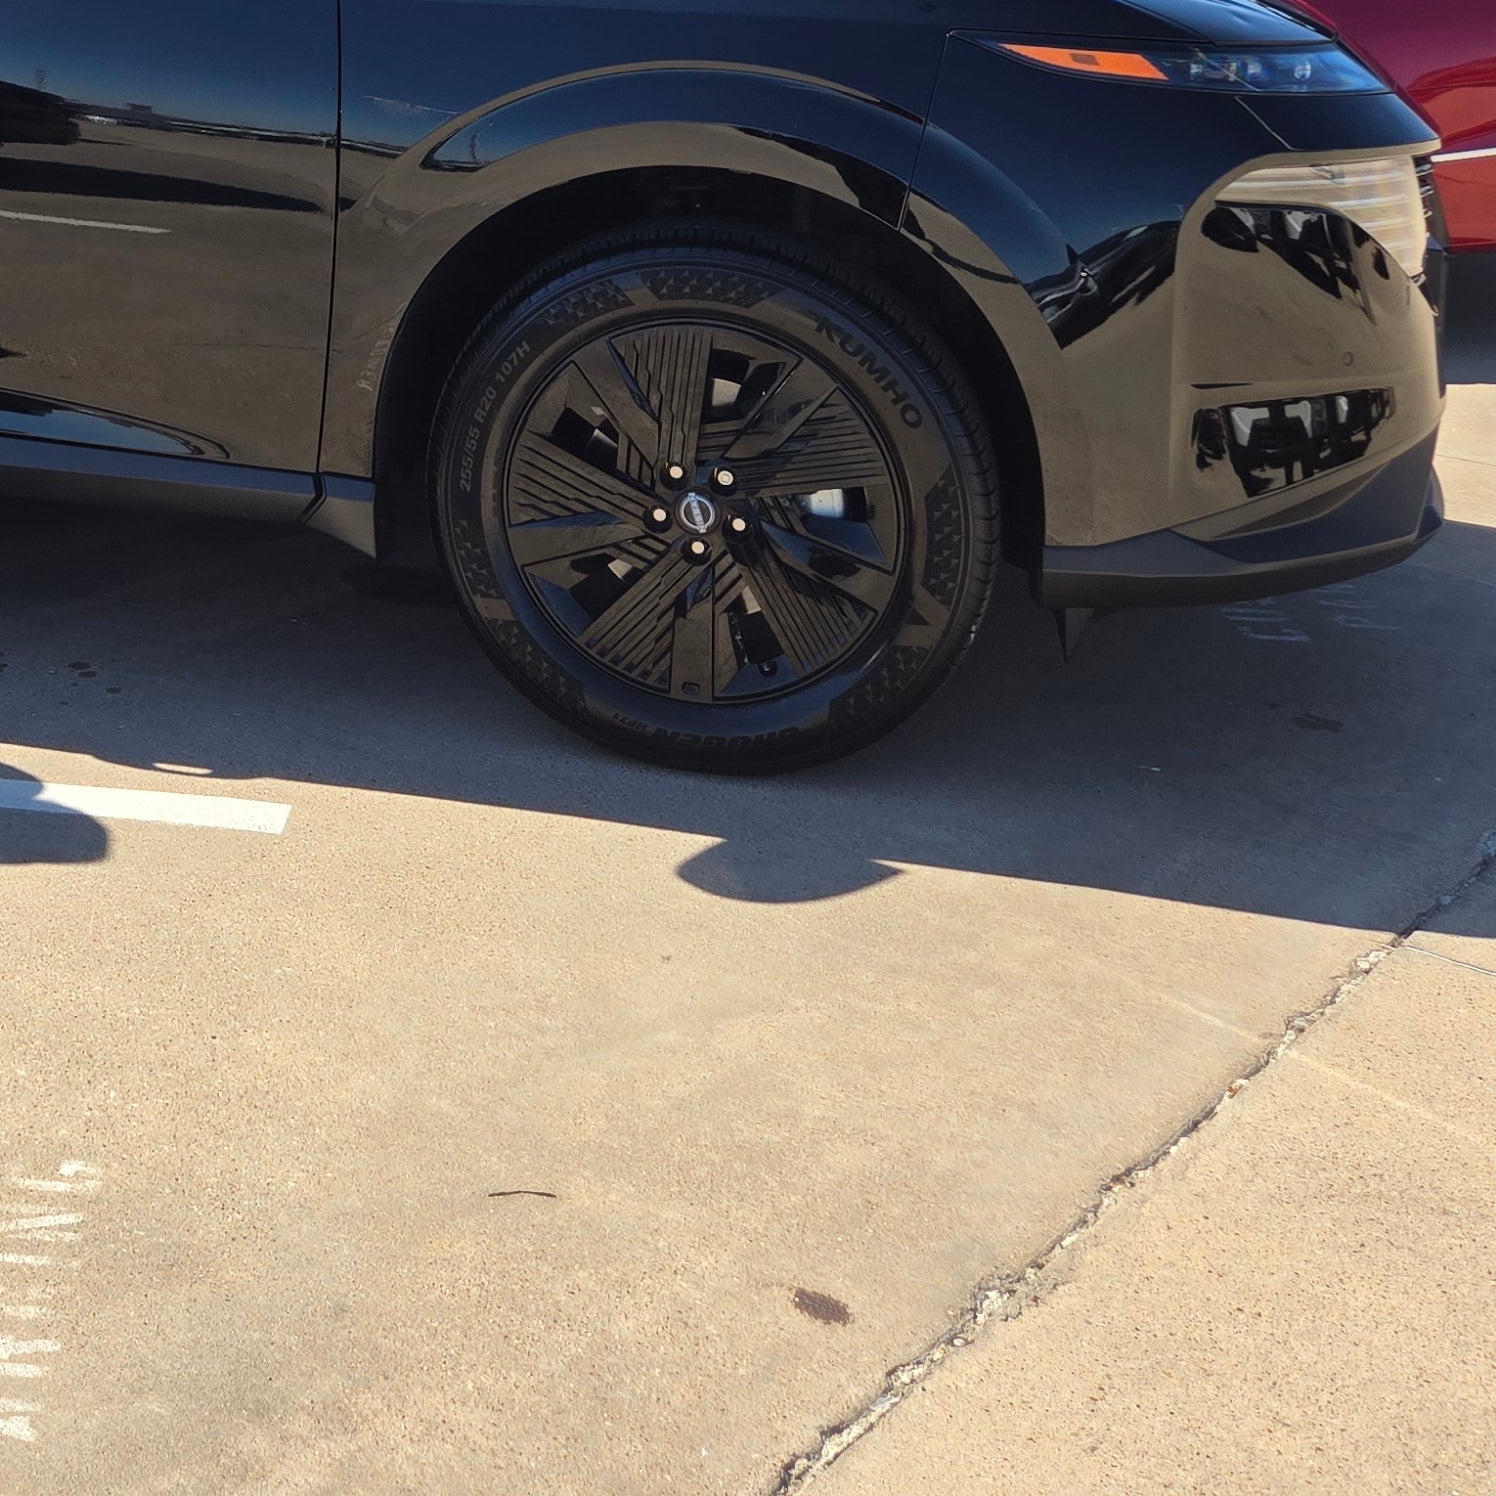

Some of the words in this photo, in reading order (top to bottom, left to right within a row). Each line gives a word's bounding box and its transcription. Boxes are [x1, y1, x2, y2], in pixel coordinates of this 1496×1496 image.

[459, 425, 481, 493] 255/55
[473, 386, 497, 424] R20
[495, 340, 531, 383] 107H
[806, 312, 923, 429] KUMHO
